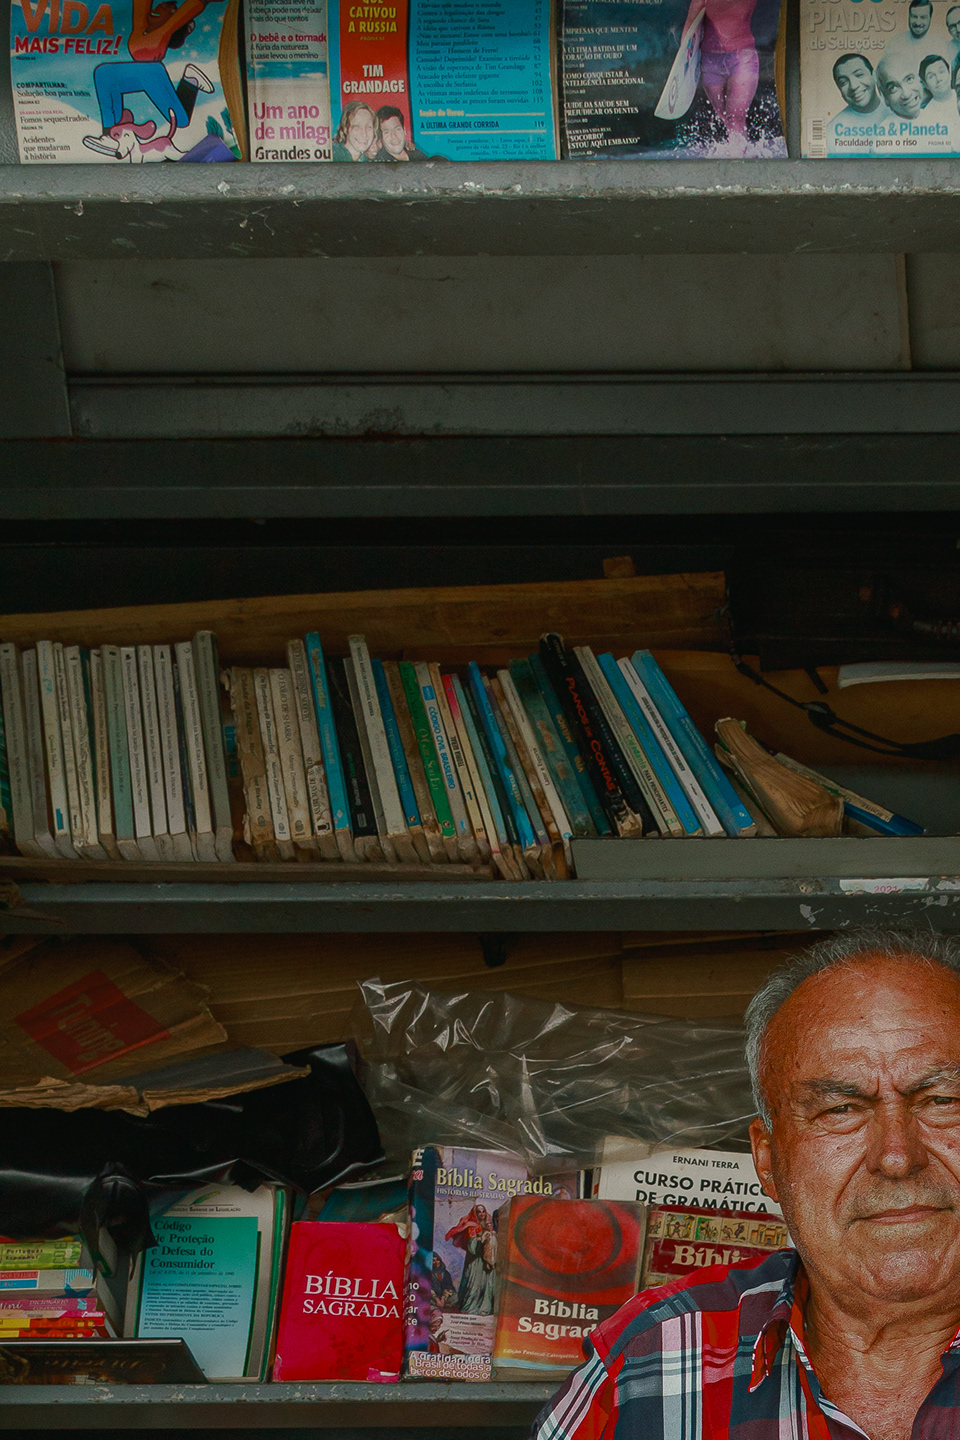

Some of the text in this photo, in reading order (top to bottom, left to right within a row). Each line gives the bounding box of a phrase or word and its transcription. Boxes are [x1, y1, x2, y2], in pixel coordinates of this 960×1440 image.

[20, 0, 114, 35] VIDA
[350, 7, 396, 18] CATIVOU
[349, 18, 397, 32] A RÚSSIA
[809, 9, 896, 33] PIADAS
[15, 35, 122, 55] MAIS FELIZ!
[363, 65, 384, 77] TIM
[343, 80, 405, 93] GRANDAGE
[254, 103, 320, 119] Um ano
[426, 120, 447, 129] ÚLTIMA
[449, 121, 472, 129] GRANDE
[474, 121, 499, 129] CORRIDA
[835, 123, 948, 136] Casseta & Planeta
[23, 136, 56, 144] Acidentes
[835, 138, 873, 147] Faculdade
[876, 139, 893, 148] para
[903, 138, 917, 146] riso
[566, 676, 589, 730] PLANOS
[590, 739, 616, 791] CONTAS
[428, 706, 441, 735] CÓDIGO
[440, 752, 455, 789] BRASILEIRO
[672, 1156, 740, 1170] ERNANI TERRA
[437, 1167, 553, 1197] Bíblia Sagrada
[633, 1170, 694, 1190] CURSO
[635, 1189, 768, 1213] DE GRAMÁTICA
[154, 1220, 192, 1231] Código
[169, 1232, 215, 1245] Proteção
[151, 1258, 215, 1270] Consumidor
[304, 1271, 399, 1300] BÍBLIA
[303, 1299, 400, 1319] SAGRADA
[534, 1298, 599, 1320] Bíblia
